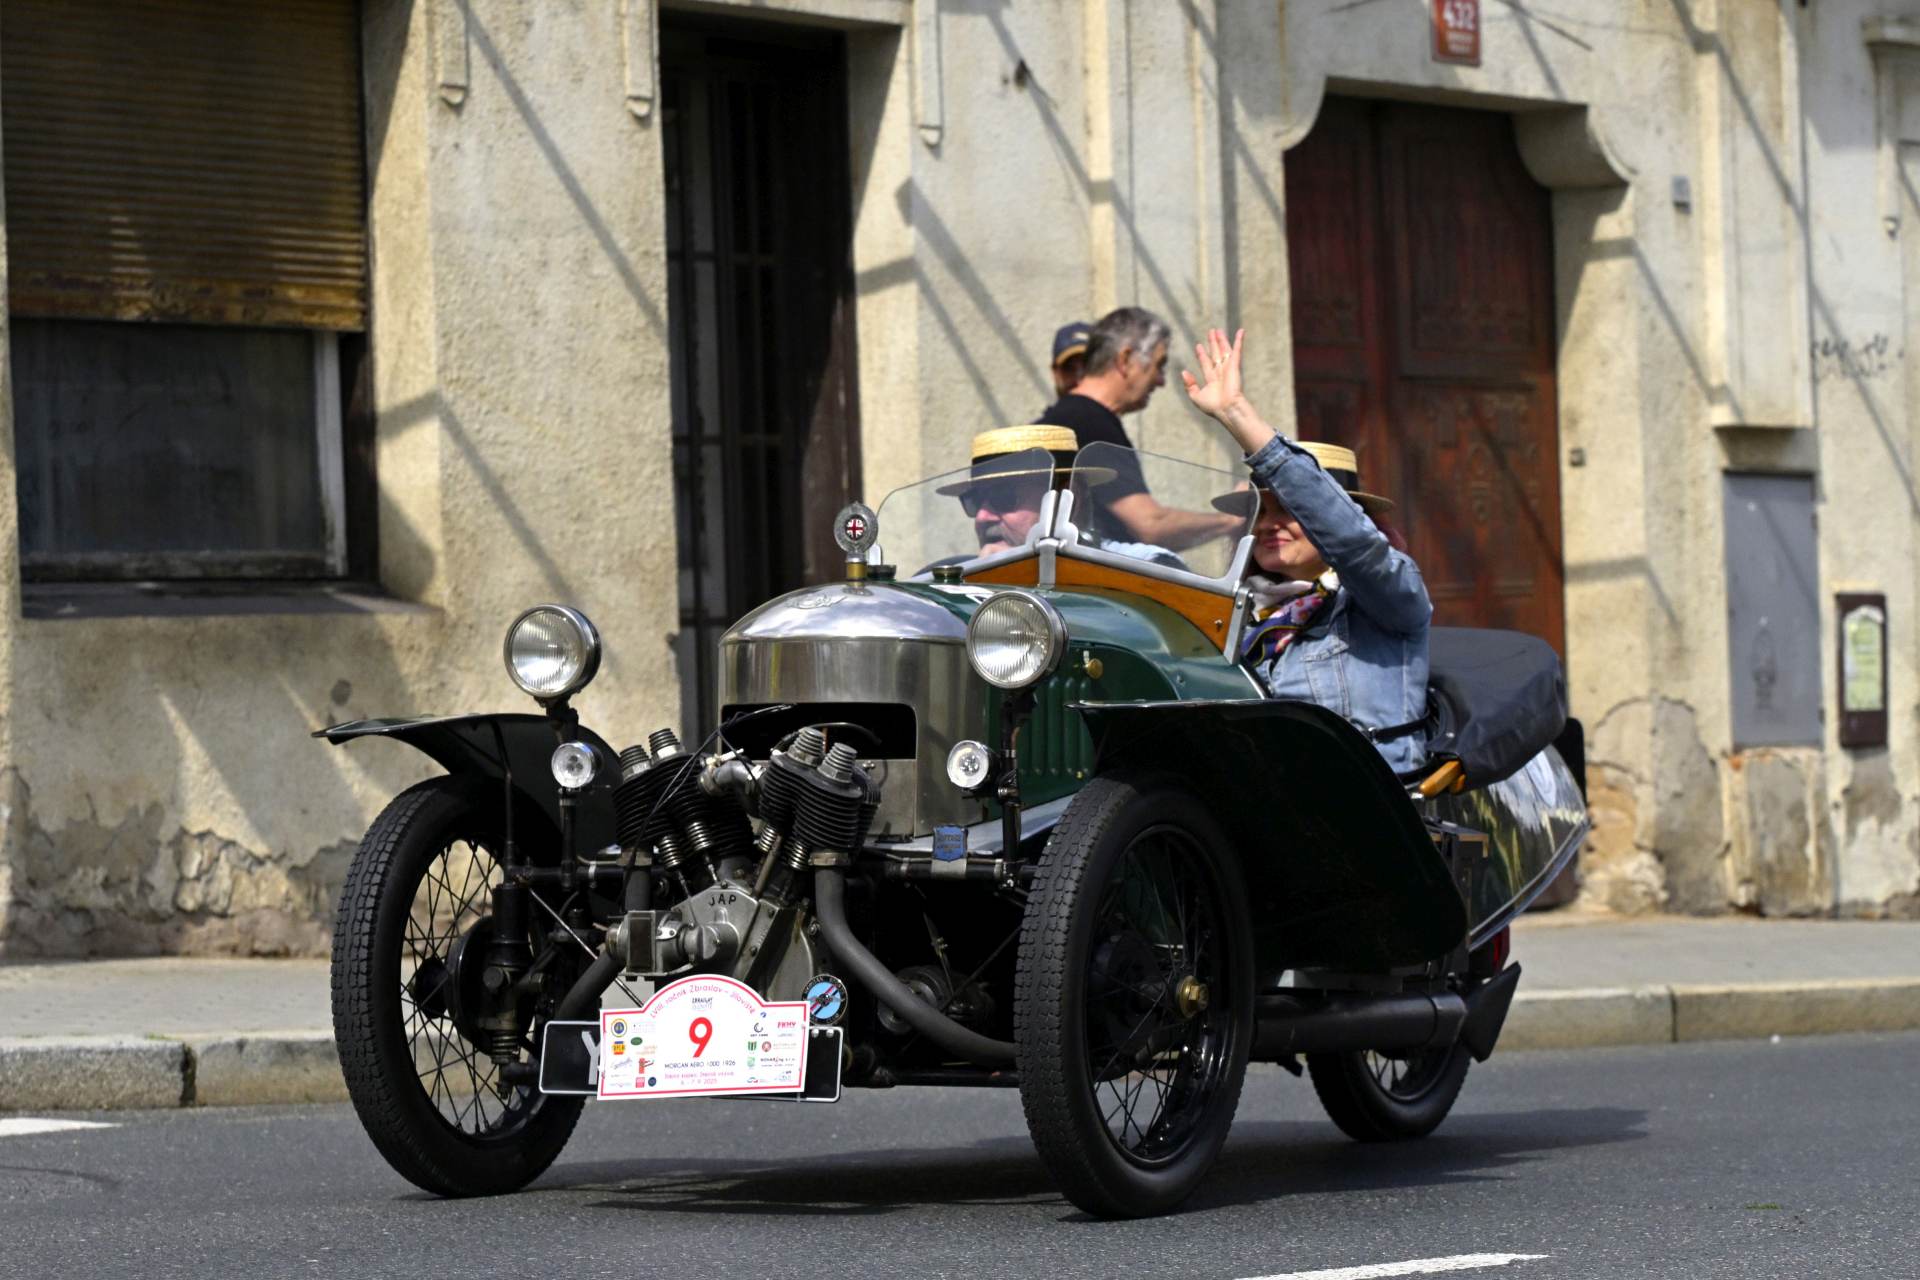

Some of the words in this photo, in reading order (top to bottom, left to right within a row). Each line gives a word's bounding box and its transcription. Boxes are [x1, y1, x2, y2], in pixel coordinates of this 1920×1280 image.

[1443, 1, 1476, 30] 432
[708, 893, 737, 906] JAP
[689, 984, 723, 994] Zbraslav
[689, 1017, 713, 1058] 9
